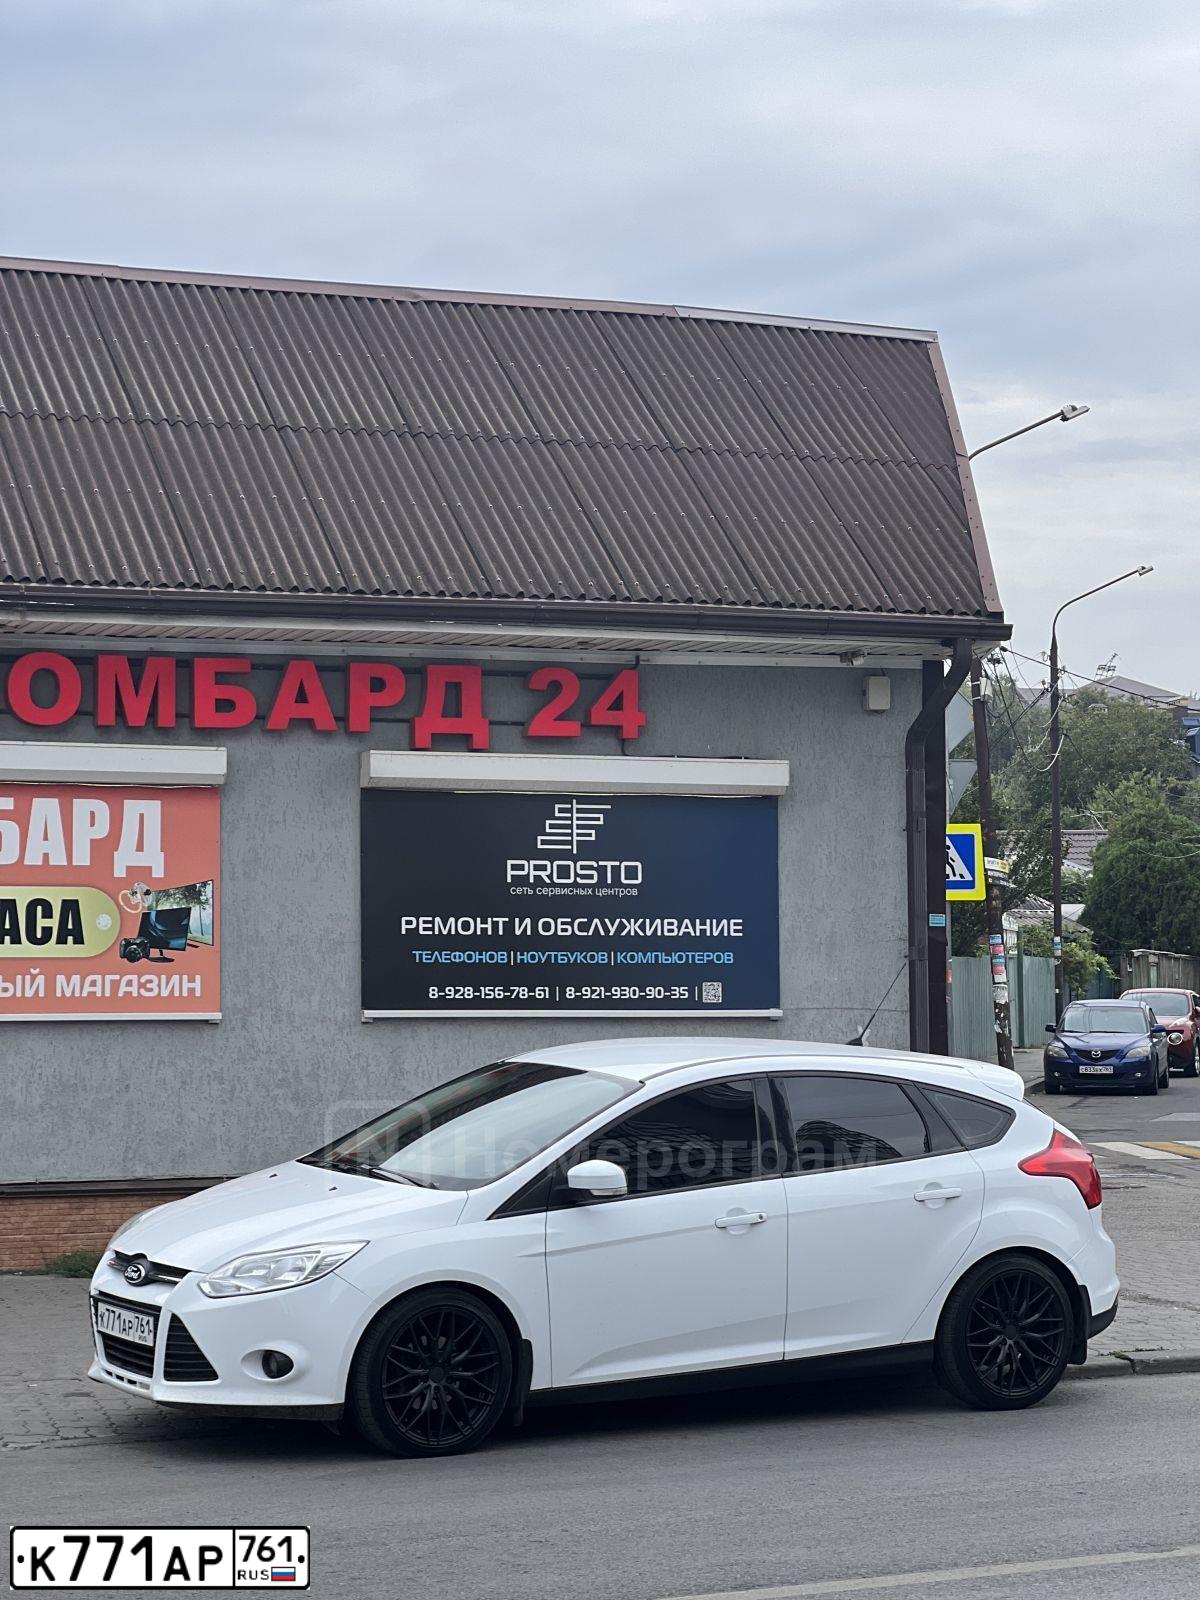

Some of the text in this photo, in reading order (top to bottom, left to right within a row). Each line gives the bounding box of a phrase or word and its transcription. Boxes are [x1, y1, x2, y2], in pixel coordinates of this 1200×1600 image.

[7, 651, 646, 749] ОМБАРД 24
[506, 860, 643, 884] PROSTO
[510, 886, 638, 897] сеть сервисных центров
[401, 916, 743, 937] РЕМОНТ И ОБСЛУЖИВАНИЕ
[412, 950, 734, 964] ТЕЛЕФОНОВ НОУТБУКОВ КОМПЬЮТЕРОВ
[55, 974, 201, 998] МАГАЗИН
[428, 986, 689, 999] 8-928-156-78-61 8-921-930-90-35
[134, 1315, 151, 1336] 761
